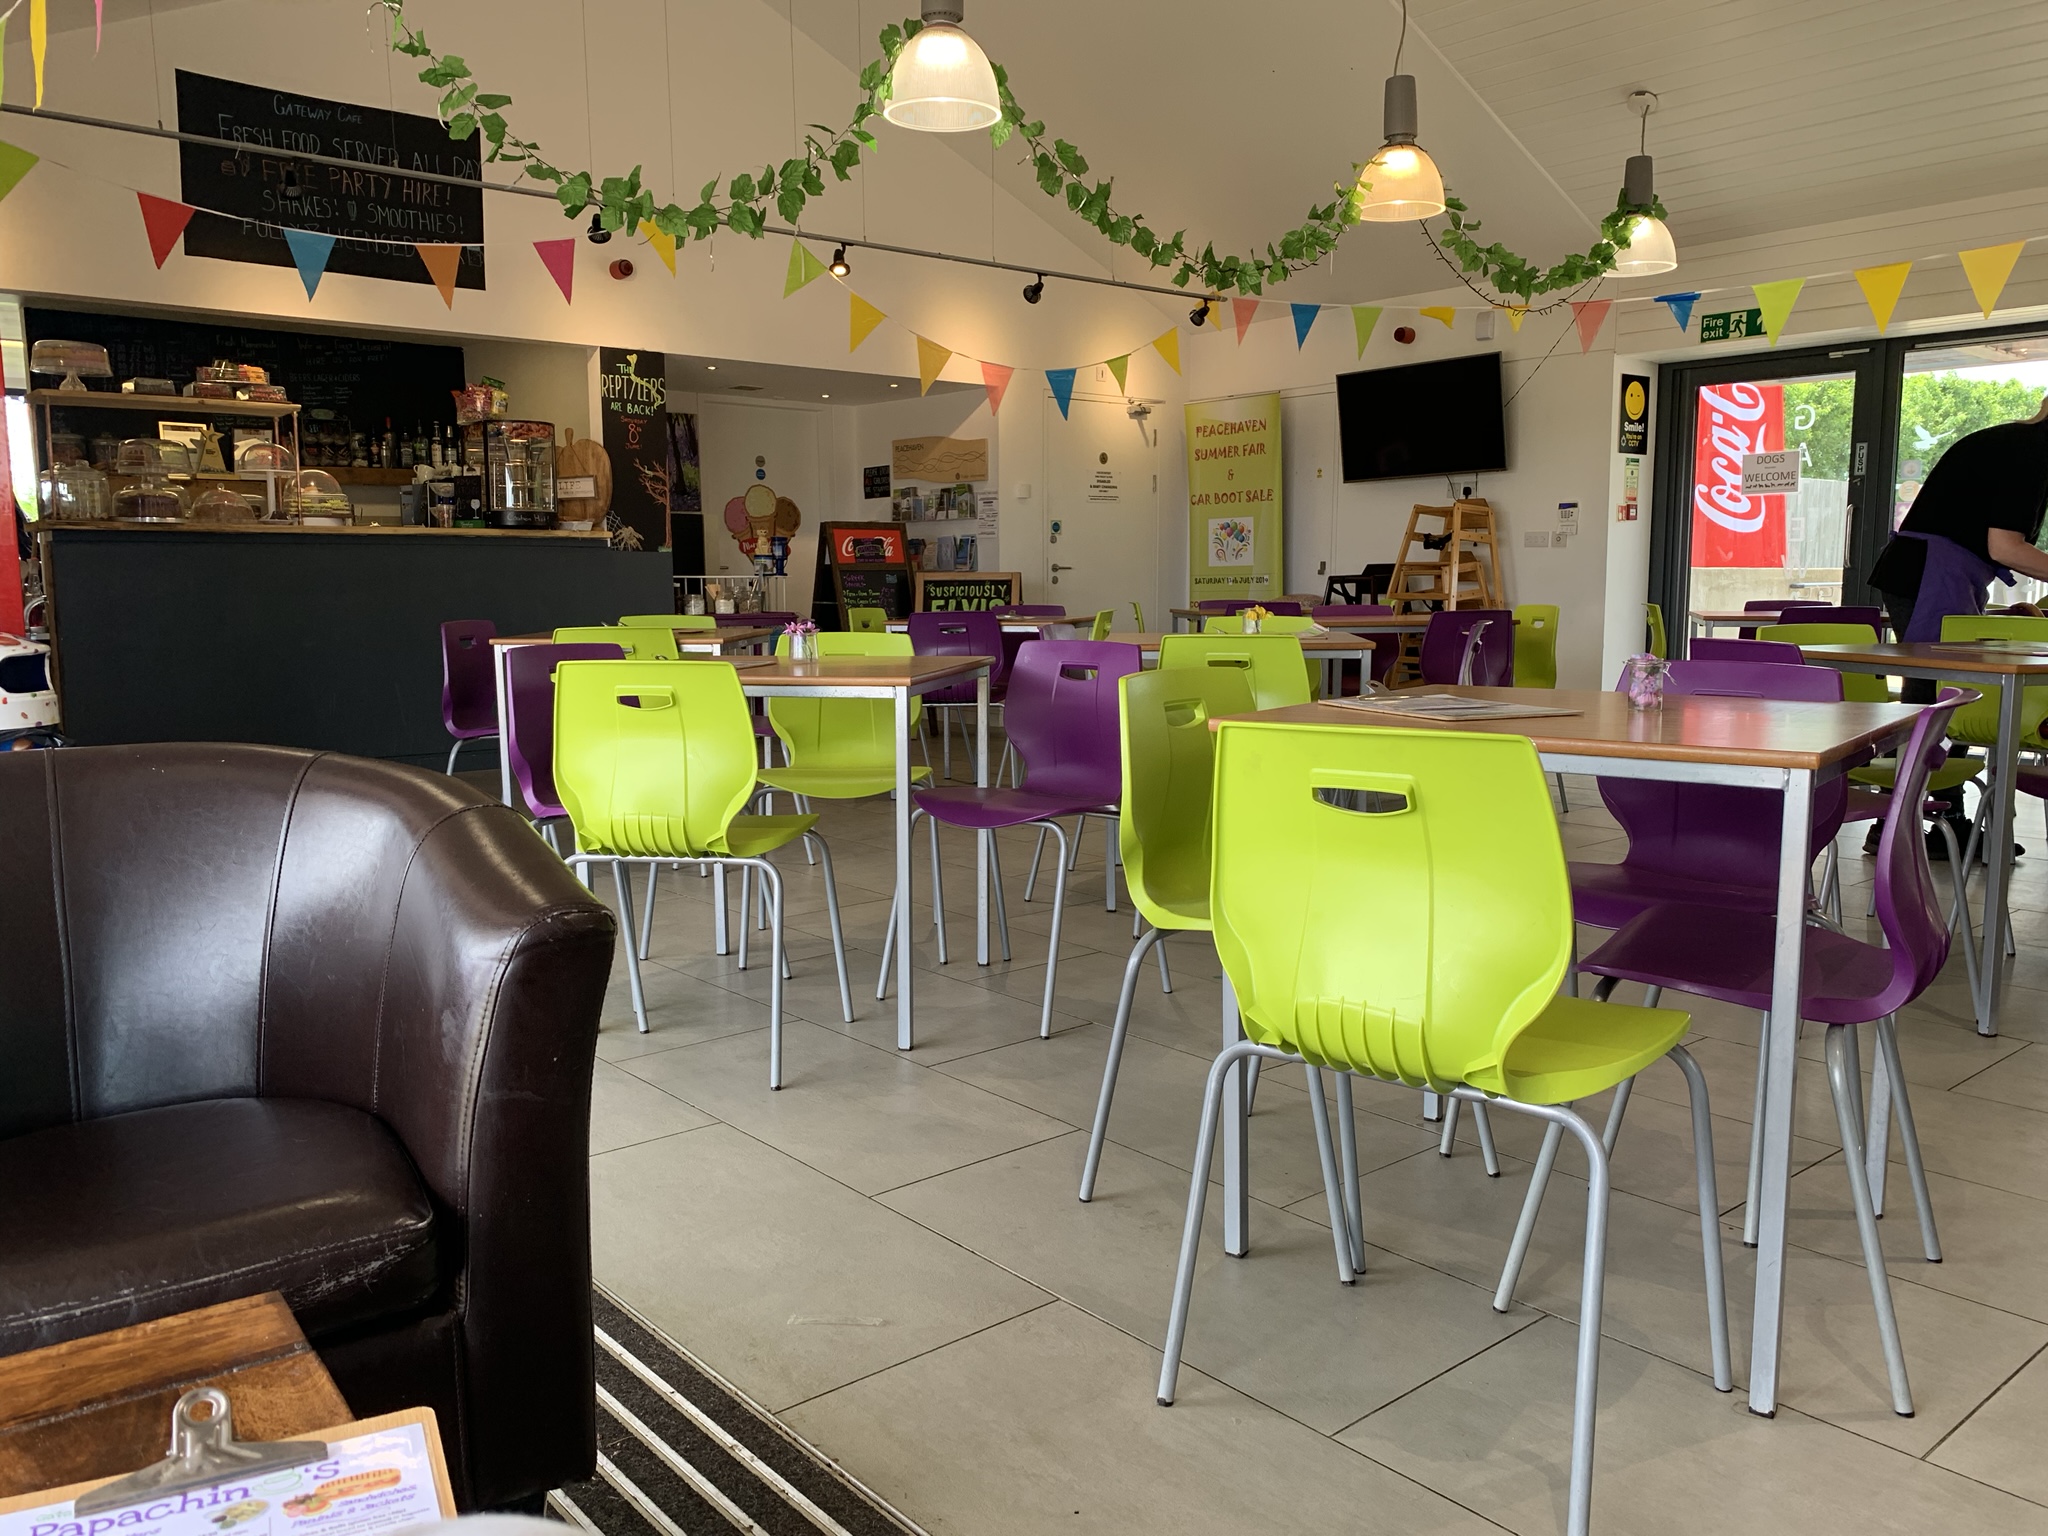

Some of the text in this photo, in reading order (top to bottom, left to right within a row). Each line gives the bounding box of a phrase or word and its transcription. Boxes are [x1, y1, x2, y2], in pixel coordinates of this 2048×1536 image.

[273, 94, 363, 125] GATEWAY CAFE
[218, 113, 482, 181] FRESH FOOD SERVED ALL DAY
[262, 159, 451, 207] FRE PARTY HIRE!
[262, 190, 464, 235] SHAKES! SMOOTHIES!
[1703, 317, 1724, 328] Fire
[1702, 328, 1723, 339] exit
[610, 402, 654, 416] ARE BACK!
[1195, 419, 1267, 438] PEACEHAVEN
[1624, 421, 1645, 433] Smile!
[1194, 443, 1266, 461] SUMMER FAIR
[1857, 445, 1865, 473] PUSH
[1757, 454, 1785, 465] DOGS
[1227, 469, 1235, 480] &
[1744, 470, 1797, 483] WELCOME
[1190, 488, 1274, 506] CAR BOOT SALE
[1239, 576, 1254, 584] JULY
[930, 584, 1008, 598] SUSPICIOUSLY
